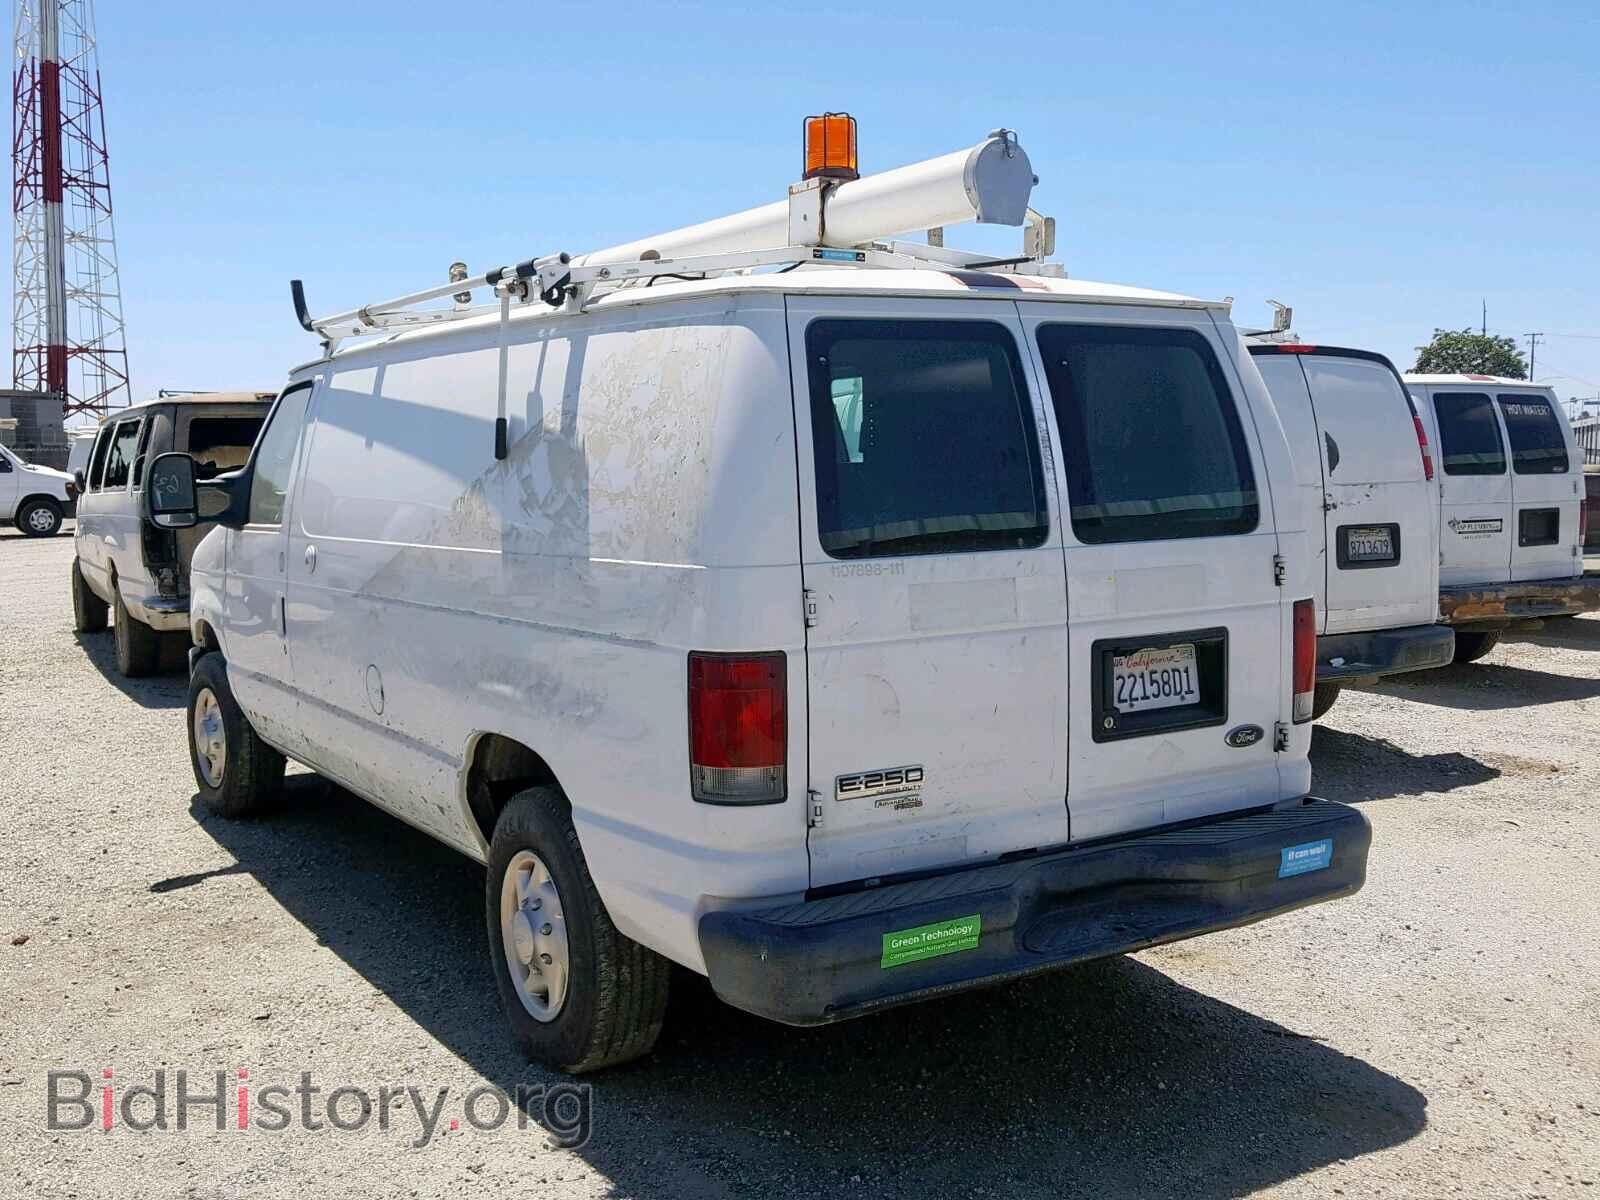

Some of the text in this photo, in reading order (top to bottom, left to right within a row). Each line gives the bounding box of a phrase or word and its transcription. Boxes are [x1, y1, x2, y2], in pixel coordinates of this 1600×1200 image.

[1116, 666, 1195, 703] 22158D1
[1236, 730, 1256, 744] Ford
[891, 925, 973, 949] Green Technology
